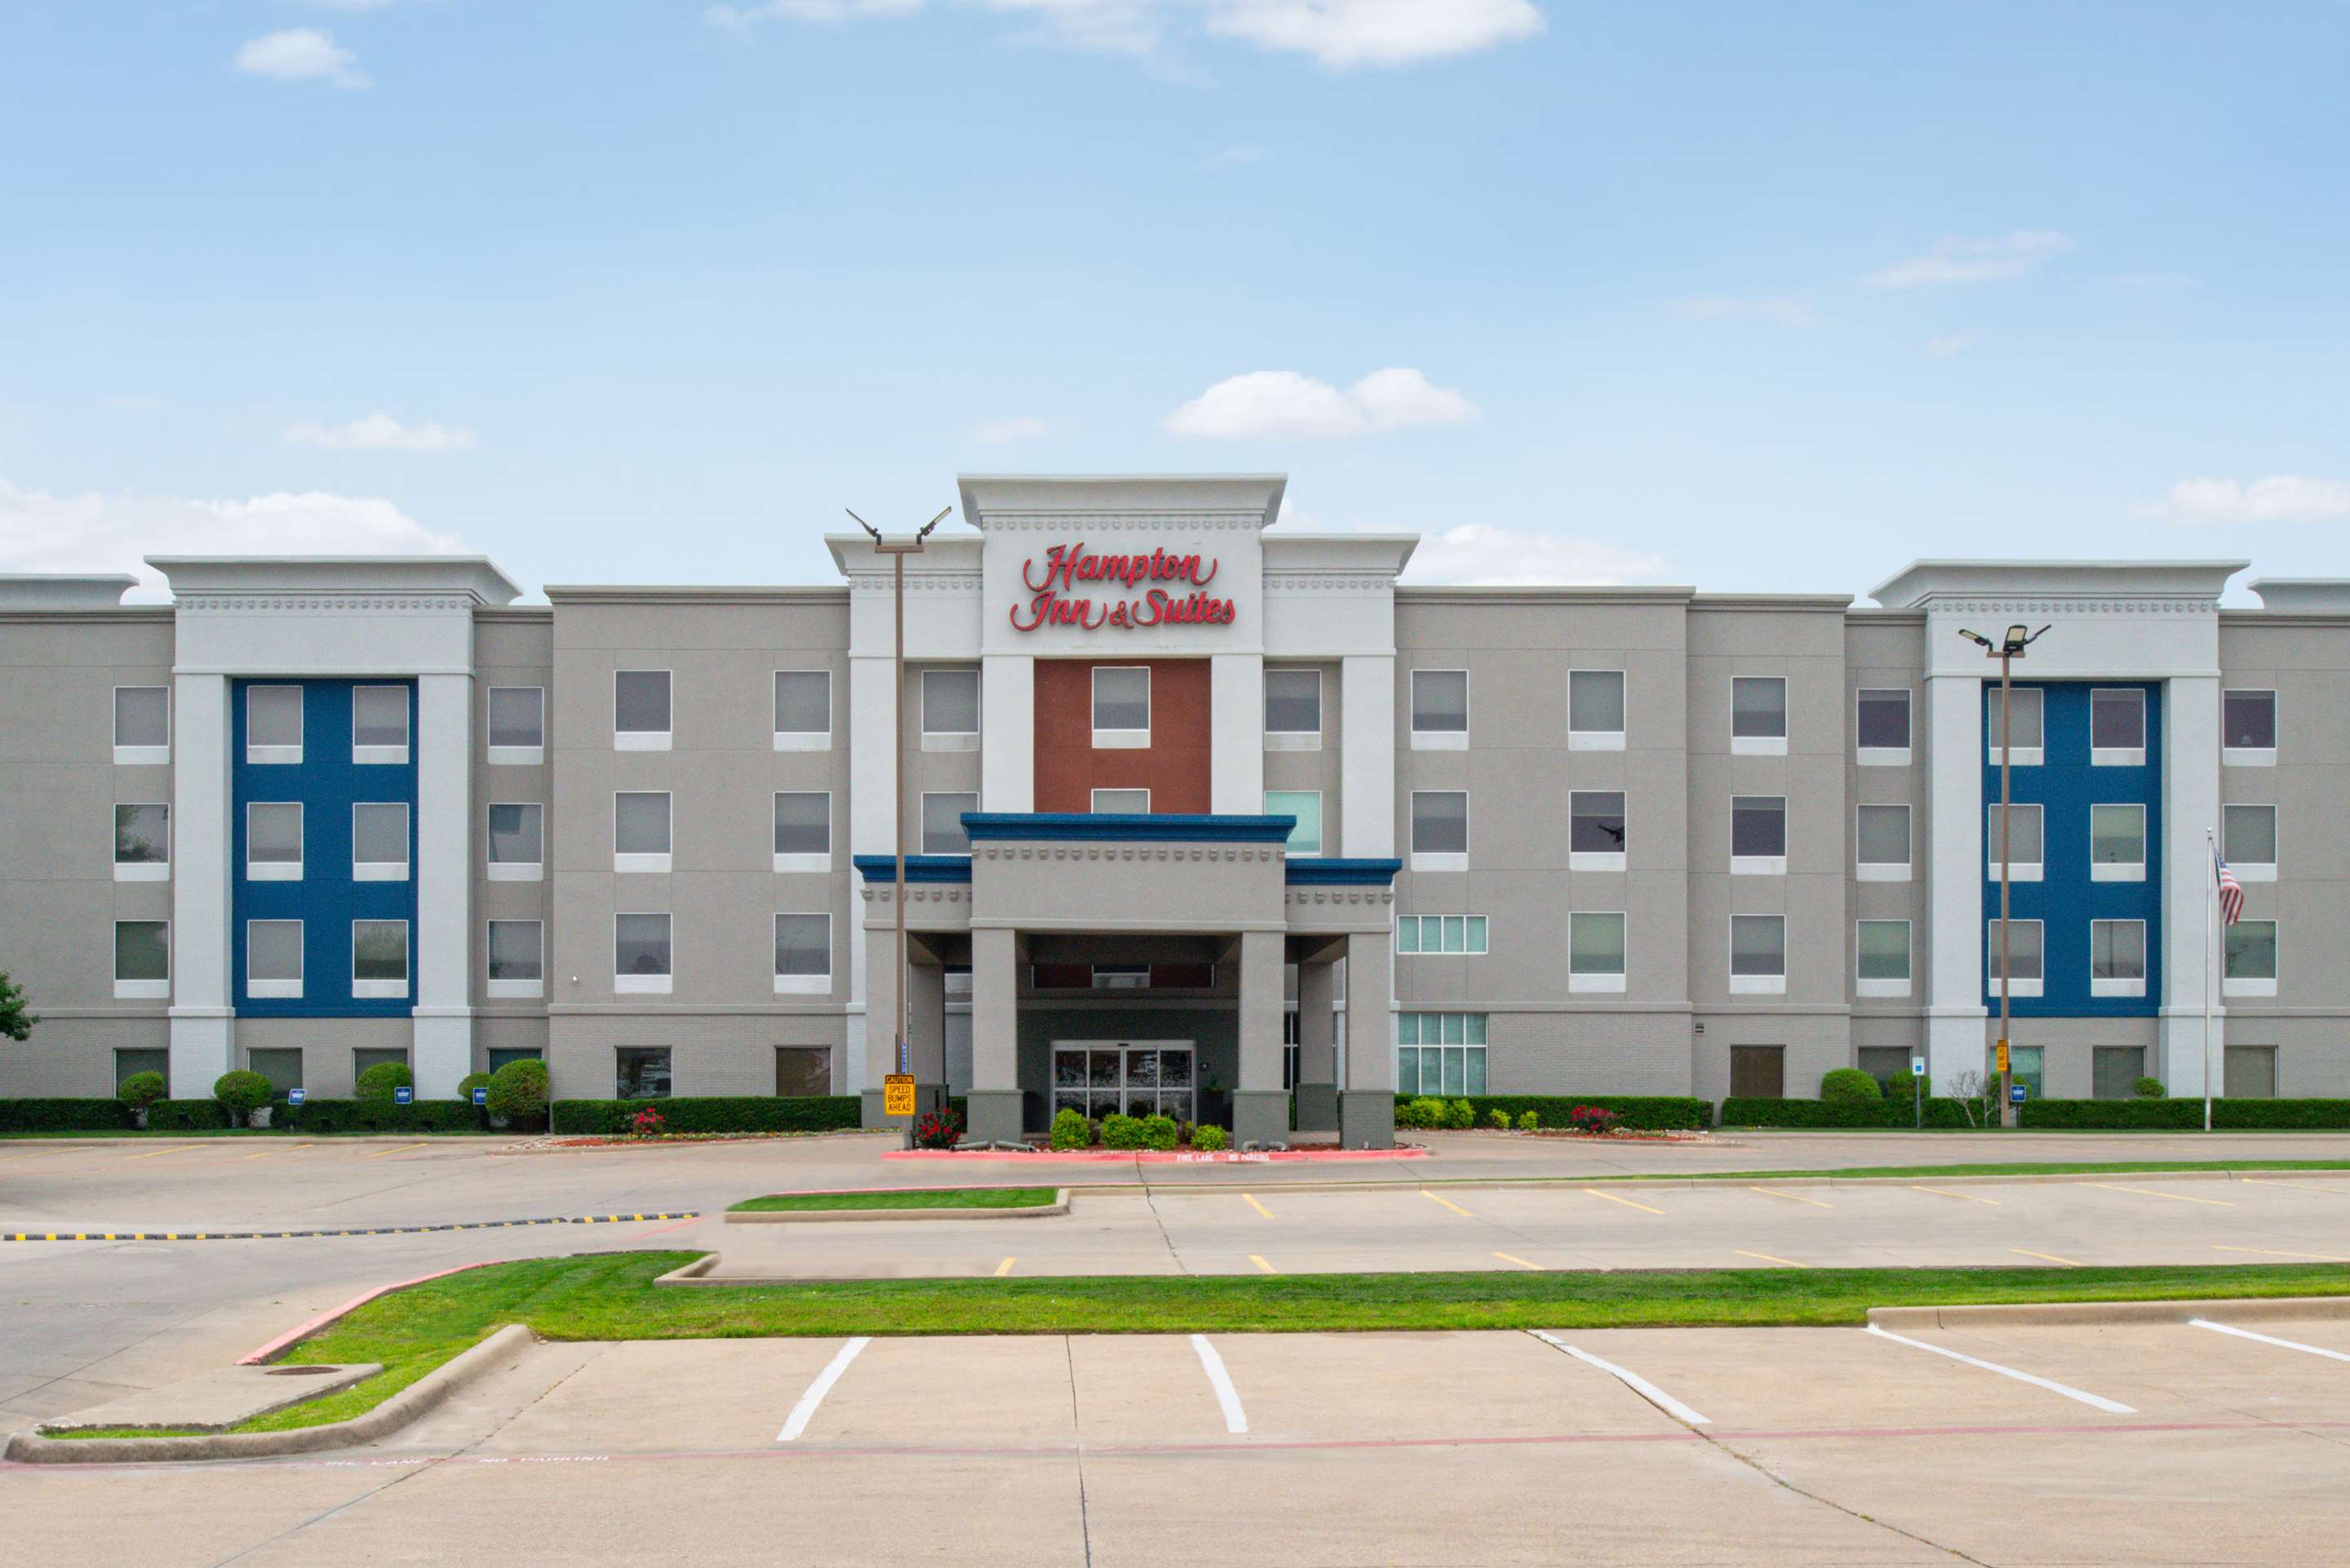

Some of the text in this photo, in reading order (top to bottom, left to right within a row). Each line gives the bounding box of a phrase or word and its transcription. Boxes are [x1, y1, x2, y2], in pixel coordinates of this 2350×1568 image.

[1023, 543, 1217, 591] Hampton
[1010, 588, 1235, 631] Inn & Suites
[1177, 1154, 1270, 1162] FIRE LANE NO PARKING
